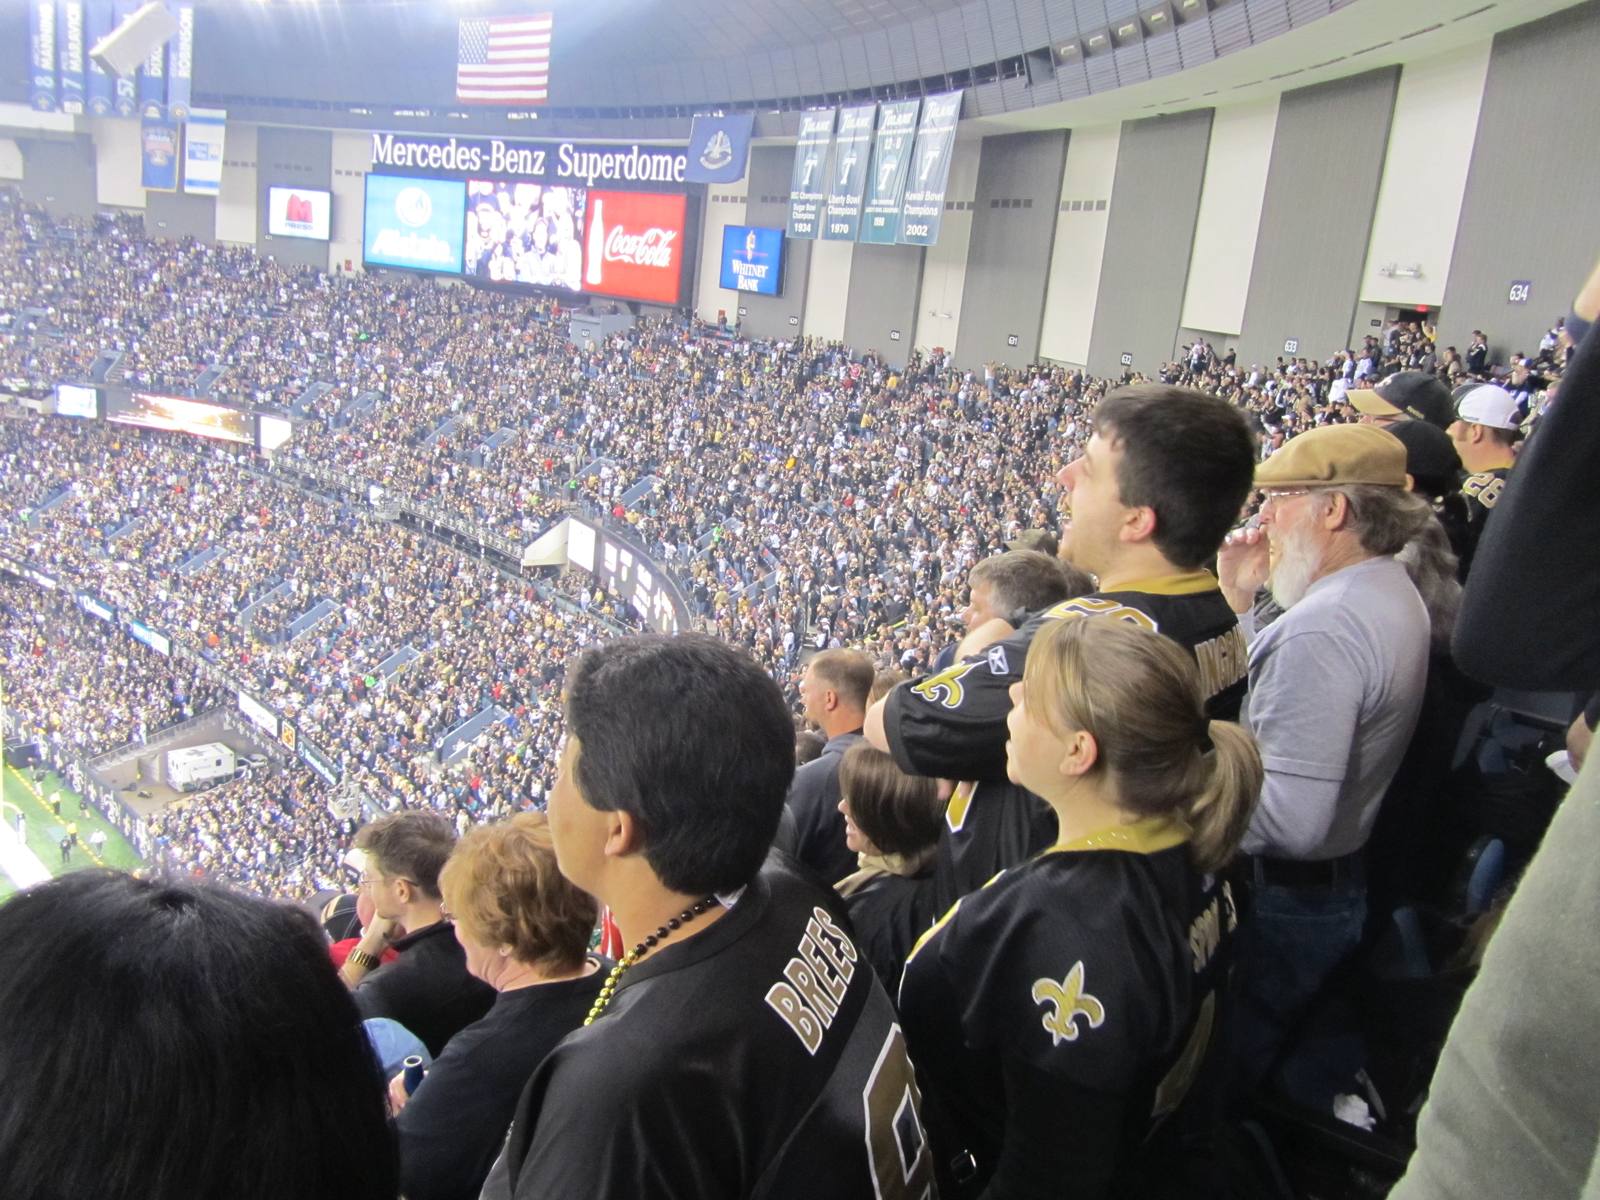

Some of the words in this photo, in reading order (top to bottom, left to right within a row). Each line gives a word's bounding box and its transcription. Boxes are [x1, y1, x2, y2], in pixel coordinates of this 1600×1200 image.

[150, 45, 163, 78] DIXO
[372, 134, 545, 175] Mercedes-Benz
[557, 143, 687, 186] Superdome
[831, 223, 849, 234] 1970
[906, 224, 928, 237] 2002
[737, 275, 759, 292] BANK
[1509, 284, 1529, 302] 634
[1284, 340, 1298, 353] 633
[764, 905, 858, 1056] BREES
